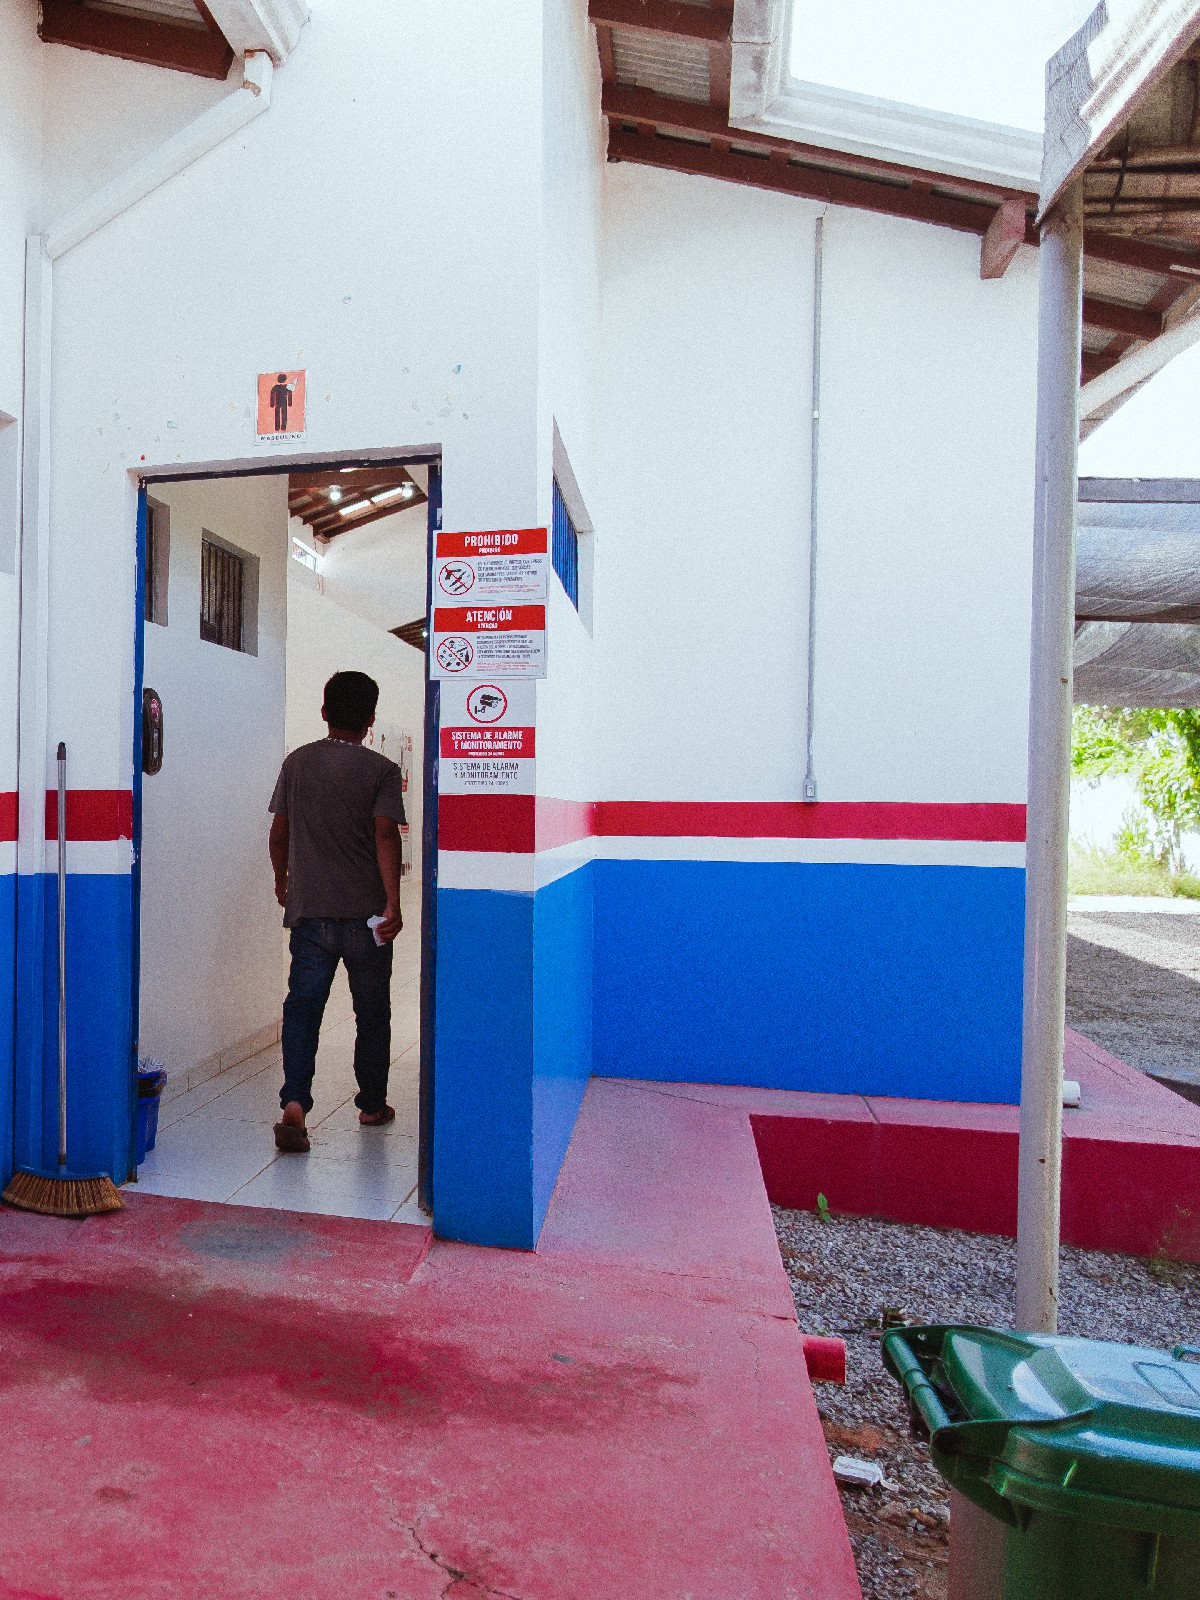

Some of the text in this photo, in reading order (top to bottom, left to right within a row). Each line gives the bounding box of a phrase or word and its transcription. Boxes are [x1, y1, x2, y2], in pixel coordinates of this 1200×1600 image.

[464, 533, 519, 547] PROHIBIDO
[465, 608, 512, 622] ATENCIÓN
[451, 730, 523, 740] SISTEMA DE ALARME
[454, 740, 522, 750] E MONITORAMENTO
[482, 763, 490, 771] DE
[492, 762, 519, 771] ALARMA
